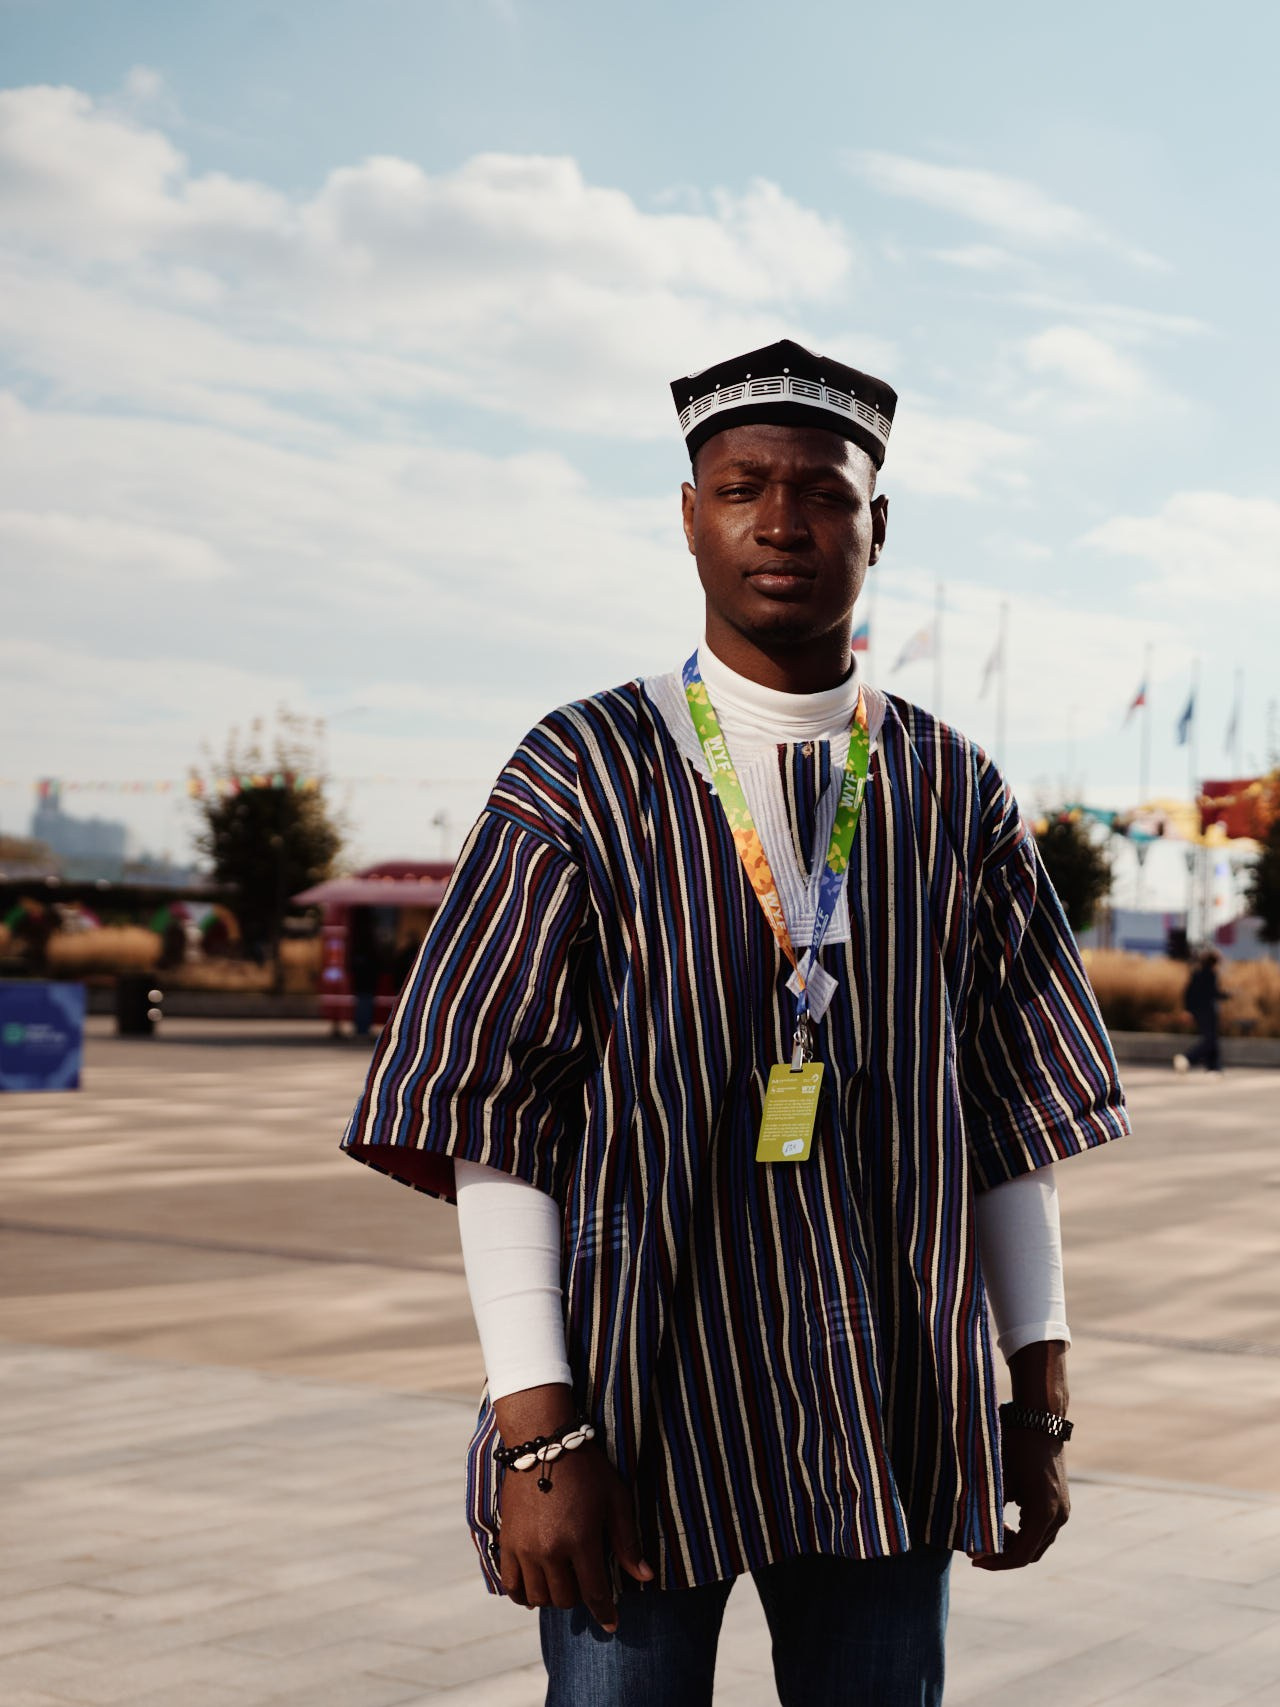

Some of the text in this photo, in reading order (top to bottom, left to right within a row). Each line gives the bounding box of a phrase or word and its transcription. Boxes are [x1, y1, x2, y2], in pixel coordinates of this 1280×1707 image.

[709, 735, 731, 769] WYF
[840, 772, 857, 807] WYF
[766, 892, 787, 930] WYF
[813, 907, 824, 946] WYF
